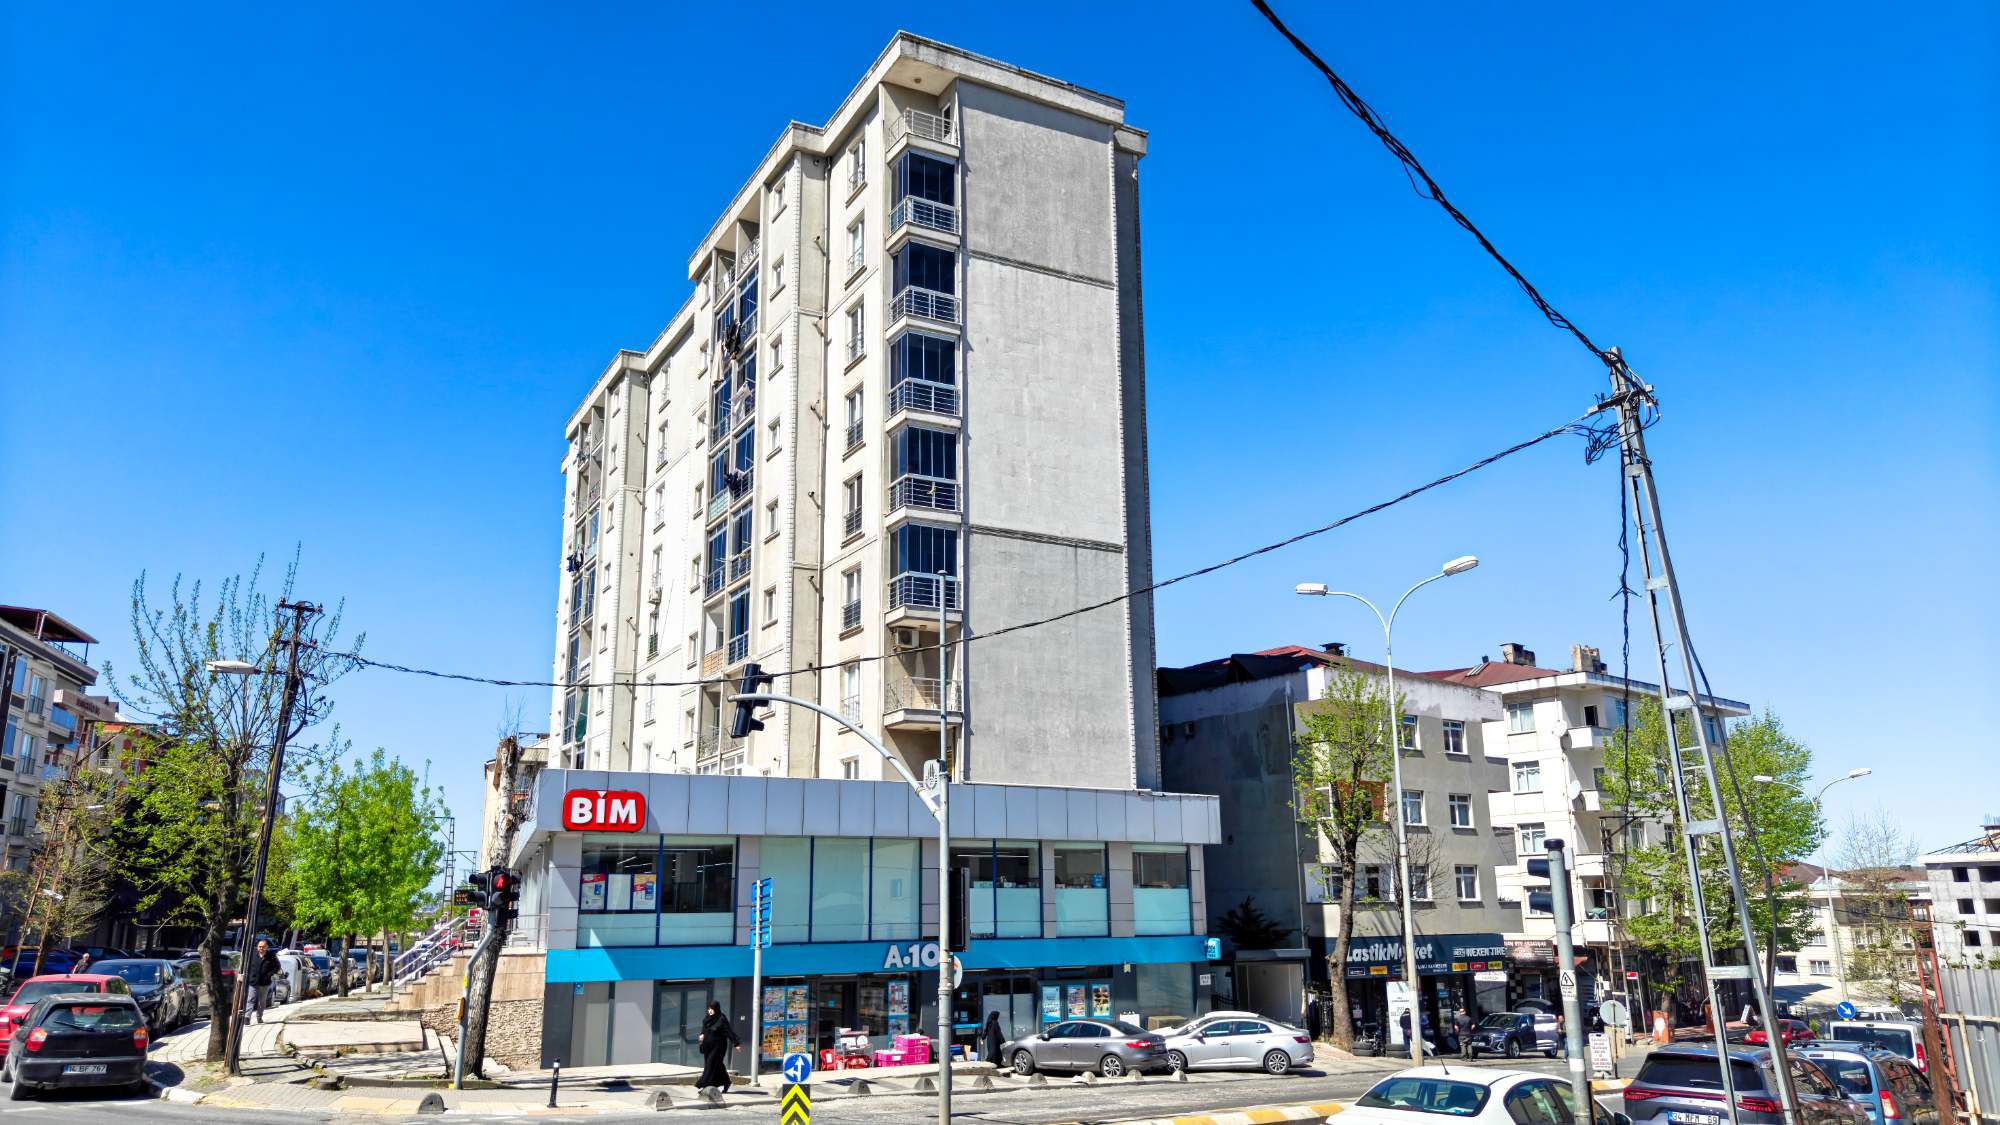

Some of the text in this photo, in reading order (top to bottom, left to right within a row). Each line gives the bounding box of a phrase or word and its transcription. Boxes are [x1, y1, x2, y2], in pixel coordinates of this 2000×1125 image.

[571, 791, 637, 824] BİM
[1347, 943, 1433, 961] LastikMket
[1672, 1112, 1682, 1121] 34
